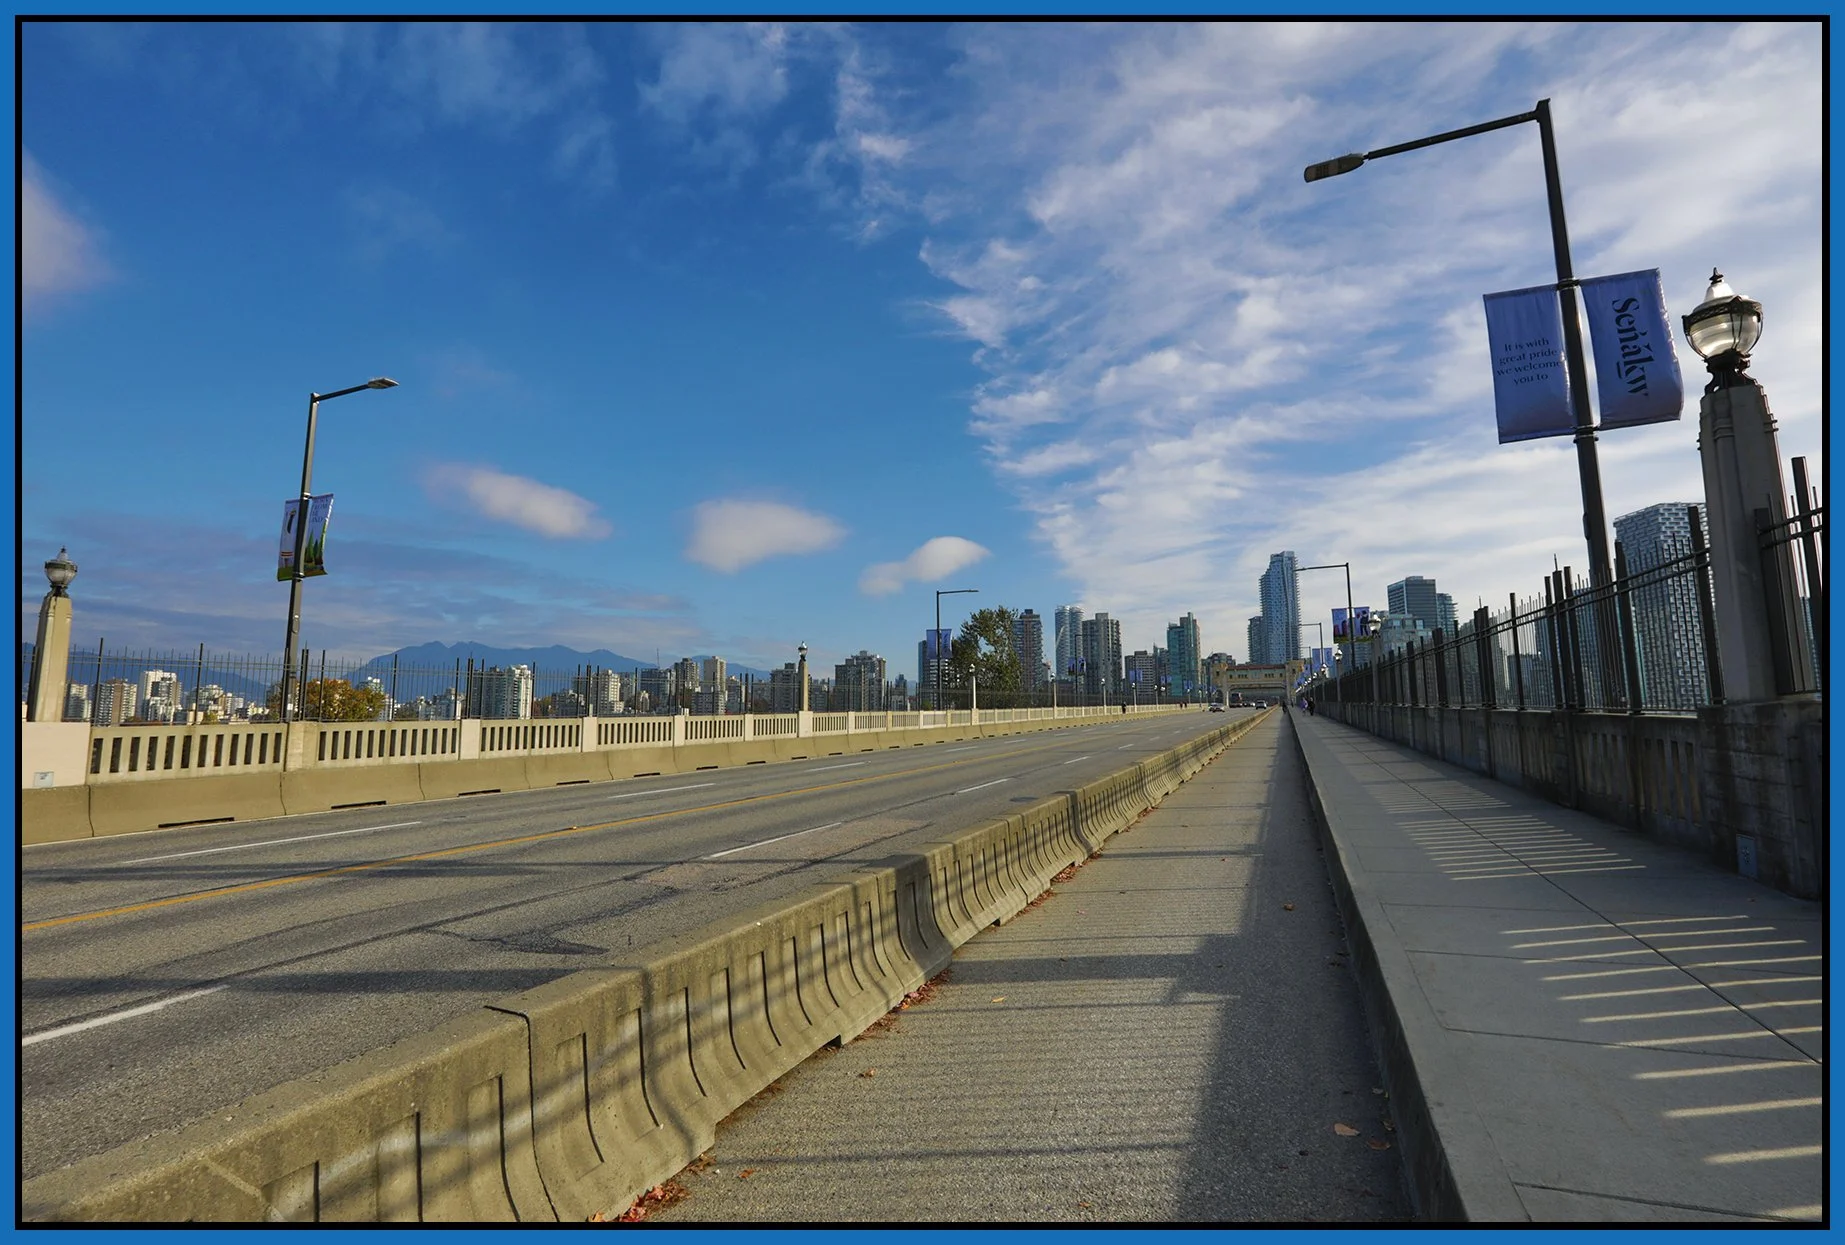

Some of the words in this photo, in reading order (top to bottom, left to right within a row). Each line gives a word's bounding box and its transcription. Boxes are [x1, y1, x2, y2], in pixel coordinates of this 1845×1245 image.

[1504, 343, 1512, 352] It
[1515, 341, 1523, 350] is
[1526, 337, 1549, 348] with
[1499, 353, 1525, 366] great
[1529, 348, 1557, 361] pride
[1496, 368, 1512, 376] we
[1513, 375, 1534, 386] you
[1536, 373, 1549, 381] to
